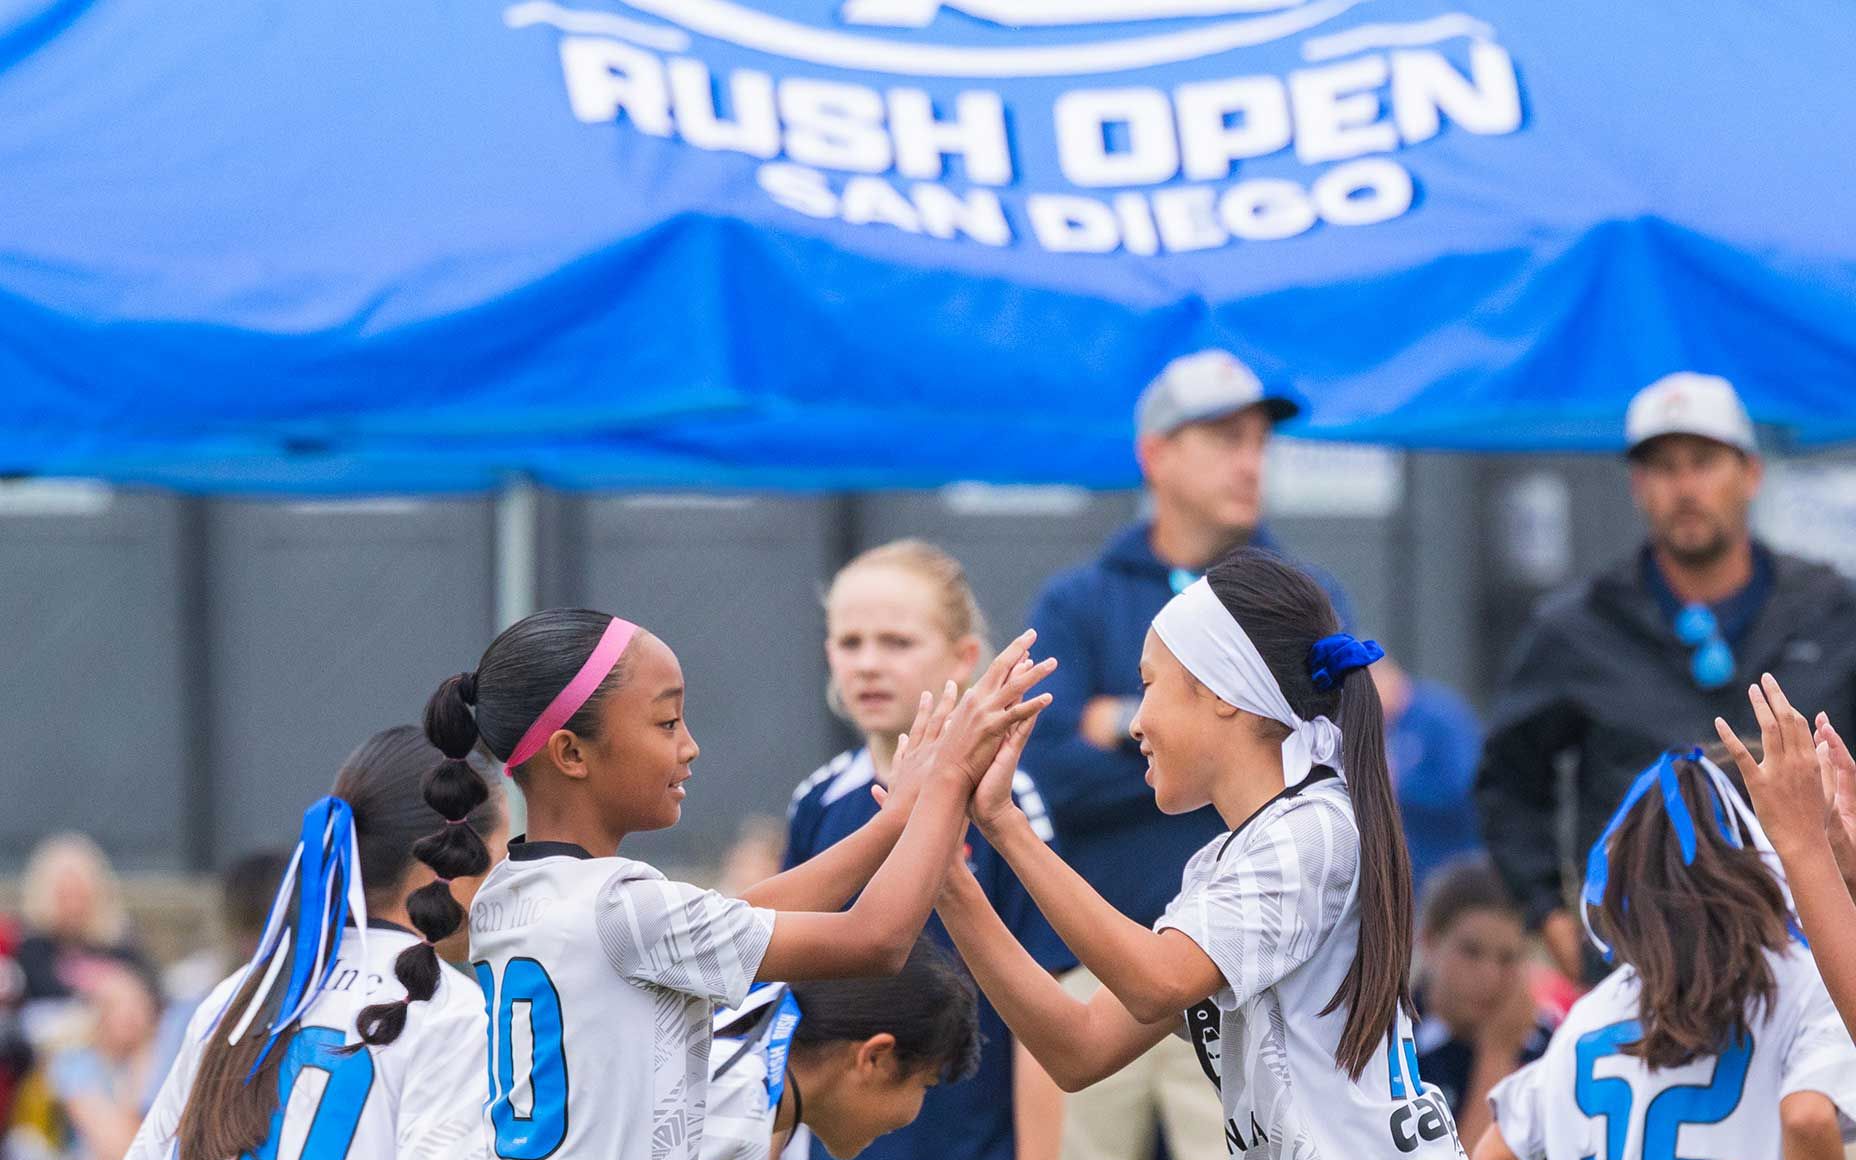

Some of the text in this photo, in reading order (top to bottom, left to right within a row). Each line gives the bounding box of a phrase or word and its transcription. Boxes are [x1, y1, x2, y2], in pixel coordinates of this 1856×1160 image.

[560, 36, 1523, 188] RUSH OPEN
[757, 157, 1415, 256] SAN DIEGO
